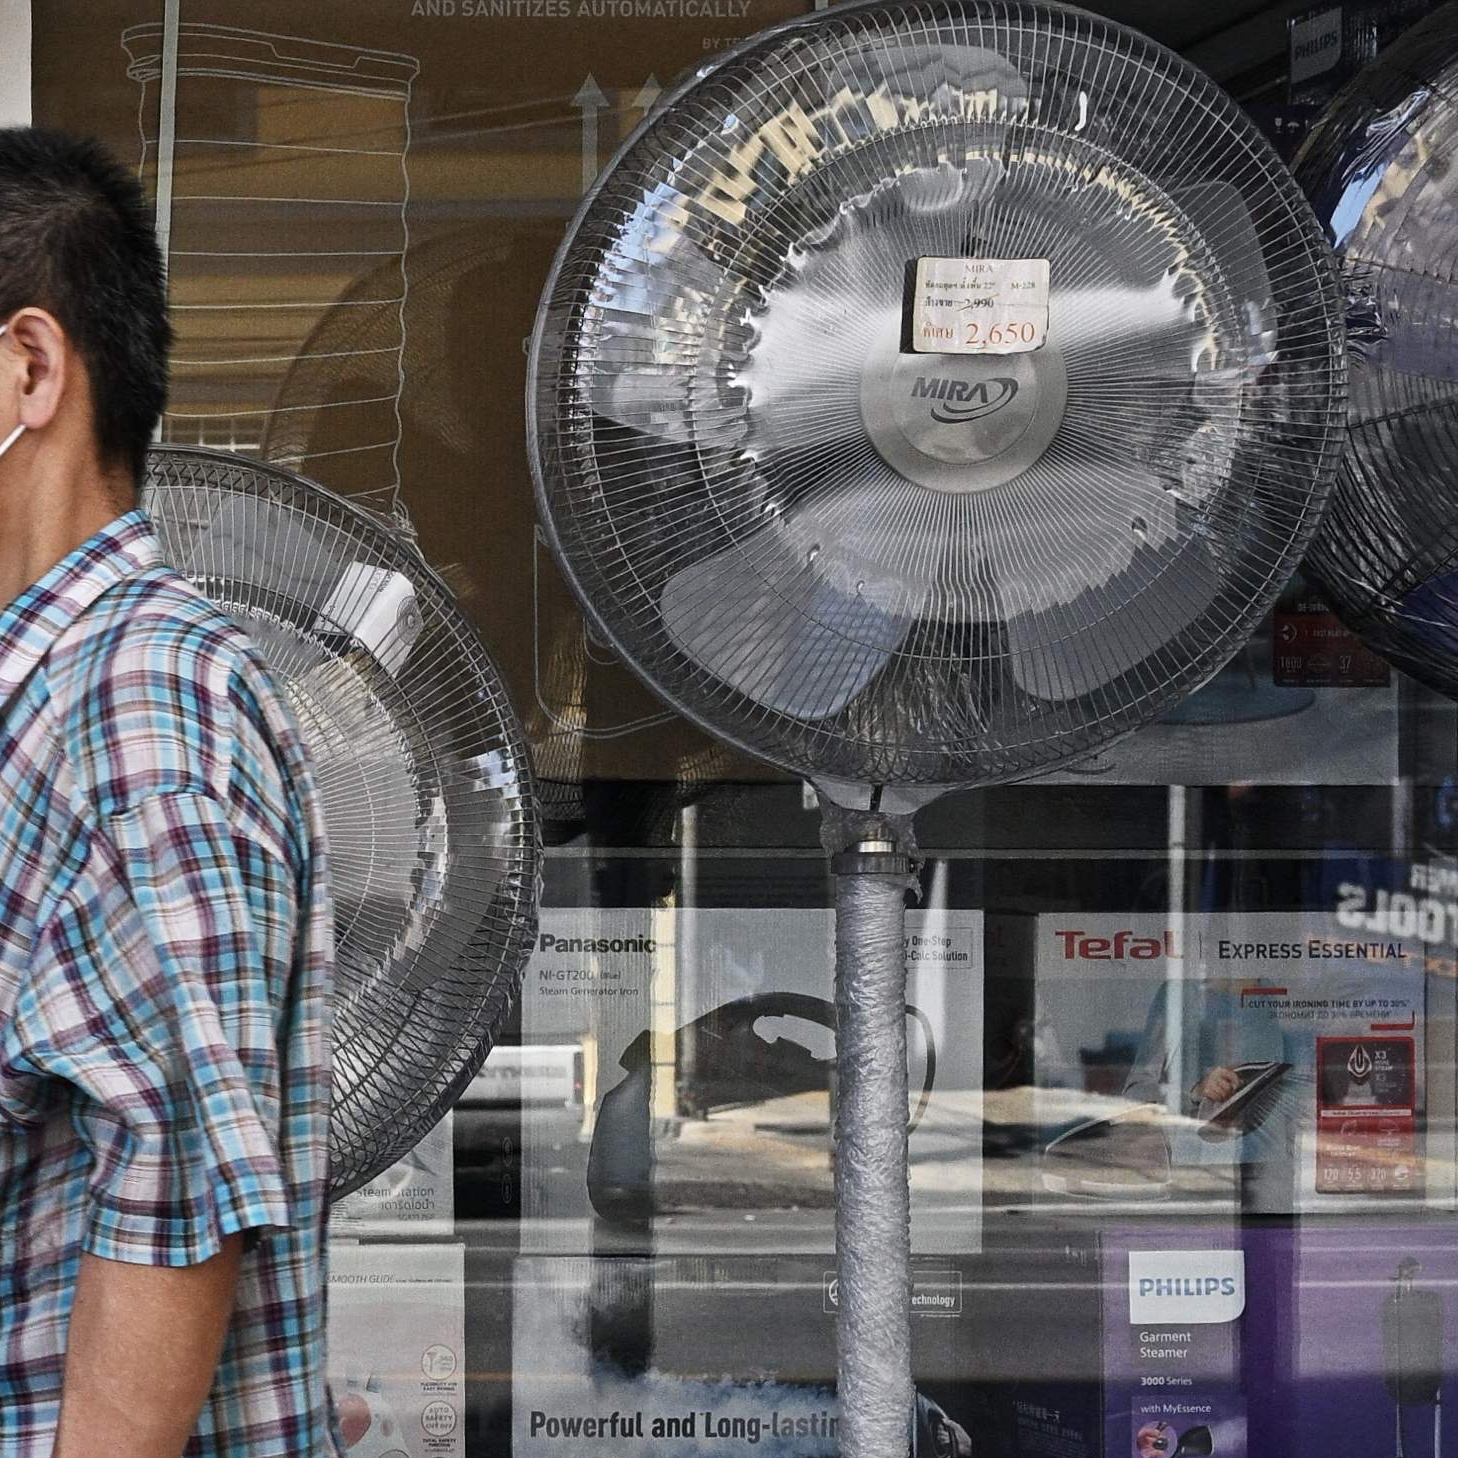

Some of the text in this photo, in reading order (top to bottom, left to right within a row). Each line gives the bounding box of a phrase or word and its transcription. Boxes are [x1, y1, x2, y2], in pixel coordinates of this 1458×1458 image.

[410, 0, 751, 17] AND SANITIZES AUTOMATICALLY
[965, 321, 1035, 345] 2,650
[910, 376, 989, 404] MIRA
[538, 933, 657, 954] Panasonic
[1054, 930, 1184, 960] Tefal
[931, 950, 968, 961] Solution
[539, 986, 639, 996] Steam Generator Iron
[1138, 1277, 1236, 1297] PHILIPS
[911, 1293, 956, 1308] echnology
[1139, 1331, 1192, 1344] Garment
[1139, 1346, 1188, 1359] Steamer
[1140, 1376, 1193, 1386] 3000 Series
[1140, 1403, 1212, 1414] with MyEssence
[530, 1410, 840, 1444] Powerful and Long-lastin
